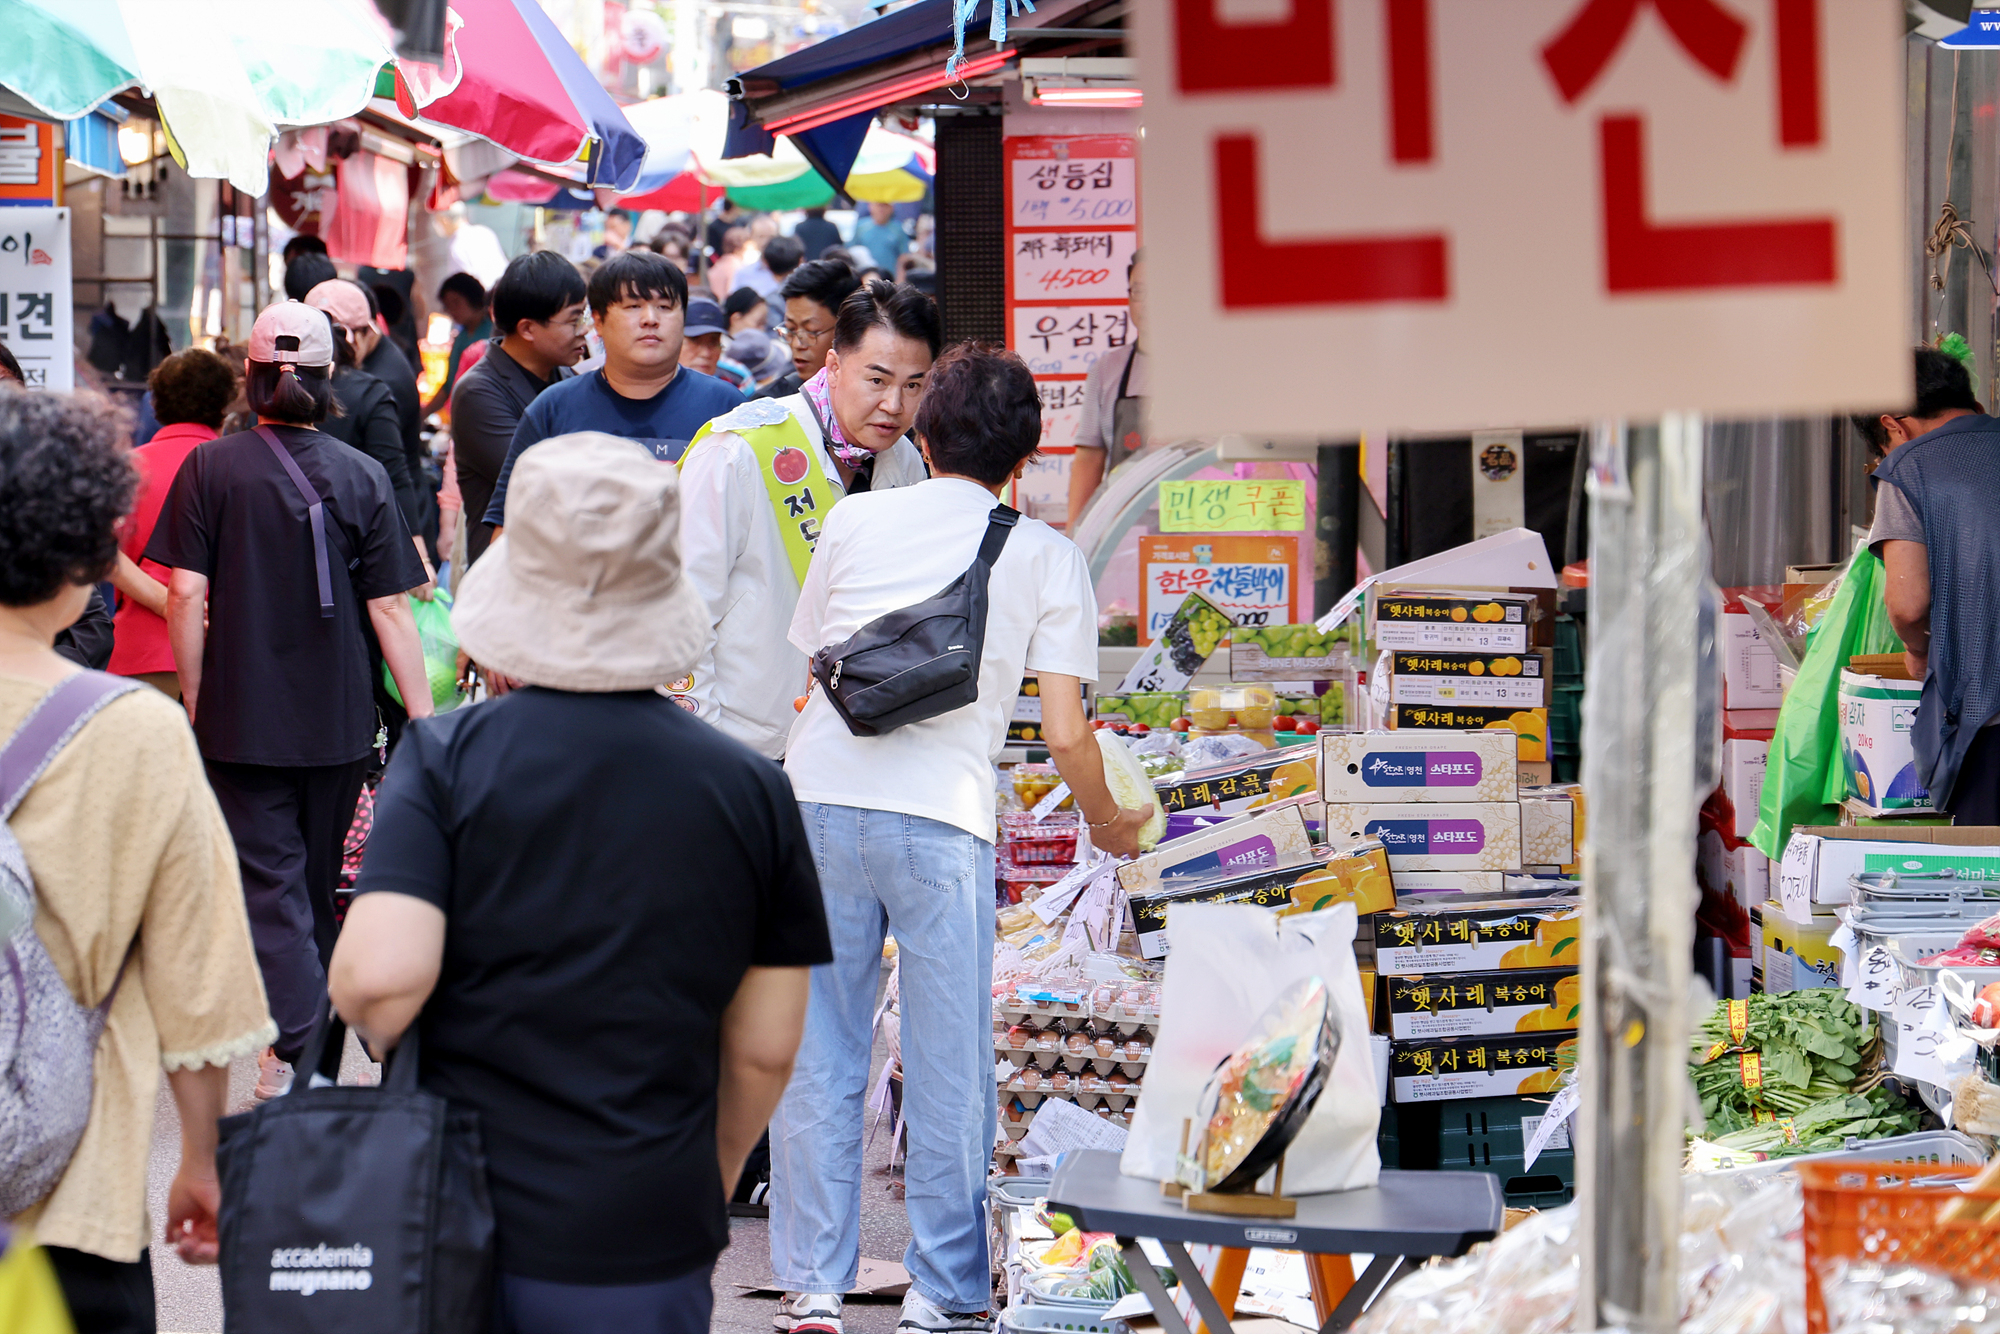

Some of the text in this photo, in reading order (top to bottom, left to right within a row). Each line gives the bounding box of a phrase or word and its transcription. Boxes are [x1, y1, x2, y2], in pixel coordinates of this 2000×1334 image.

[1028, 161, 1112, 190] 생등심
[1017, 234, 1112, 260] 제주 흑돼지
[1029, 311, 1128, 353] 우삼겹
[1170, 485, 1302, 521] 민생 쿠폰
[1155, 566, 1284, 602] 한우 차돌박이
[1479, 637, 1489, 646] 13
[1260, 657, 1338, 668] SHINE MUSCAT
[1496, 689, 1507, 698] 13
[1414, 712, 1484, 726] 햇사레 복숭아
[1849, 702, 1865, 727] 감자
[1858, 733, 1873, 749] 20kg
[1406, 765, 1423, 775] 영천
[1430, 764, 1475, 775] 스타포도
[1157, 773, 1260, 808] 사레 감곡
[1409, 833, 1425, 843] 영천
[1432, 831, 1478, 843] 스타포도
[1395, 919, 1530, 946] 햇사레 복숭아
[1816, 959, 1837, 984] 첫
[1411, 983, 1546, 1011] 햇사레 복숭아
[1413, 1047, 1548, 1075] 햇사레 복숭아
[271, 1242, 373, 1269] accademia
[269, 1270, 373, 1296] mugnano
